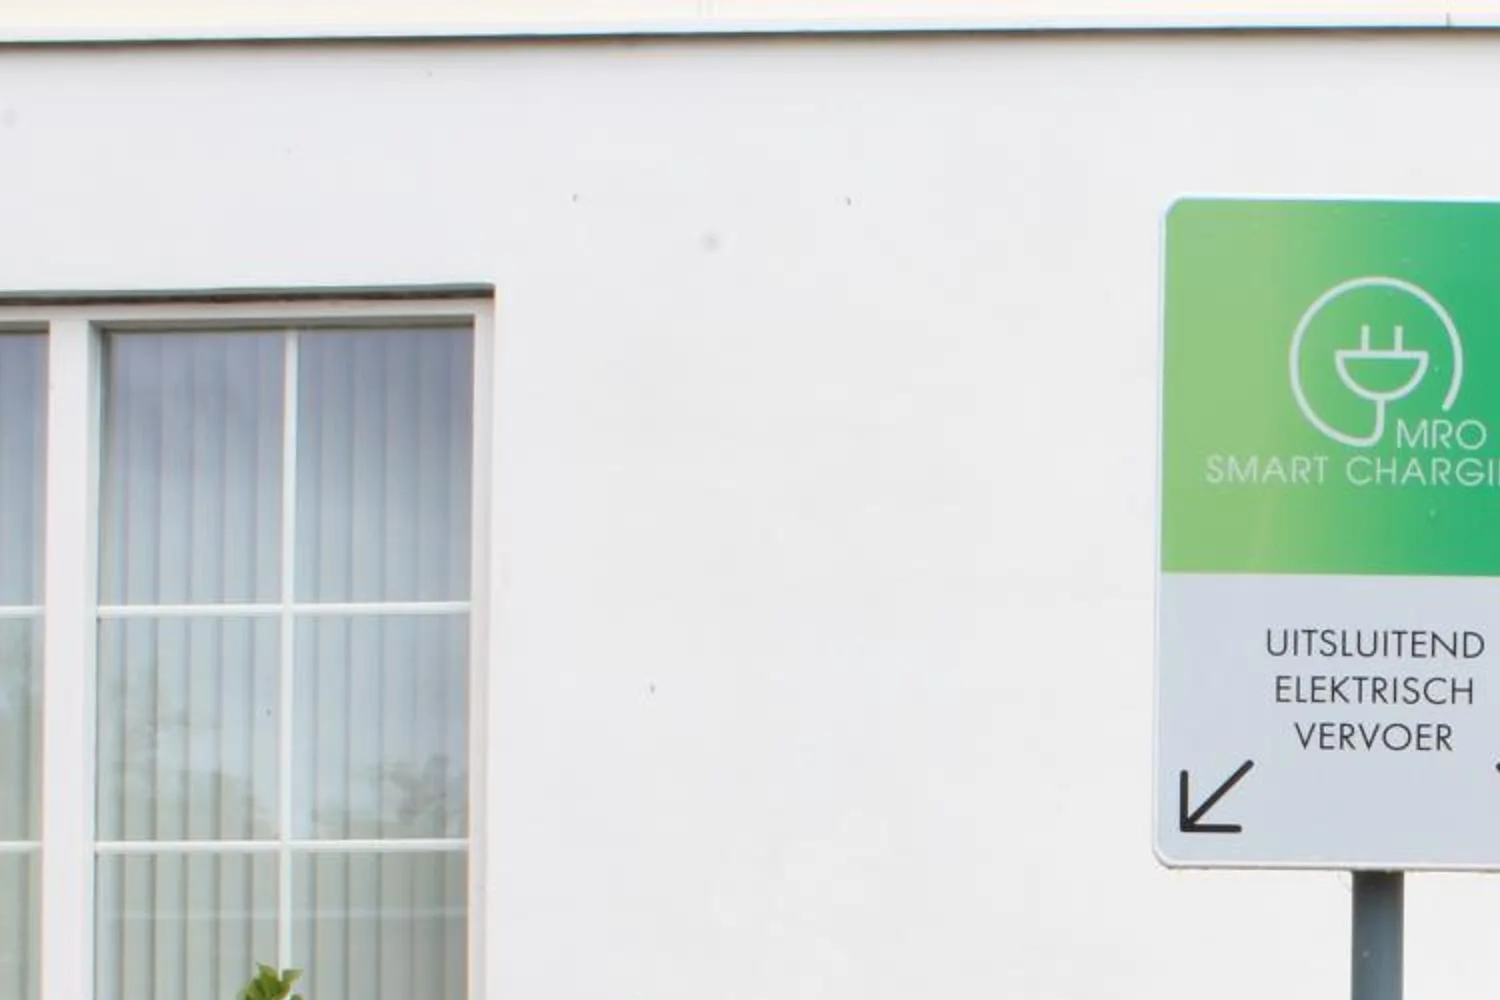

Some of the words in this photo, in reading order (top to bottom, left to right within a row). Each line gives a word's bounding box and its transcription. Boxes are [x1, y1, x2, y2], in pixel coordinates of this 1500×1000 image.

[1396, 418, 1487, 450] MRO
[1205, 454, 1329, 484] SMART
[1266, 628, 1485, 659] UITSLUITEND
[1275, 675, 1474, 705] ELEKTRISCH
[1294, 722, 1453, 752] VERVOER
